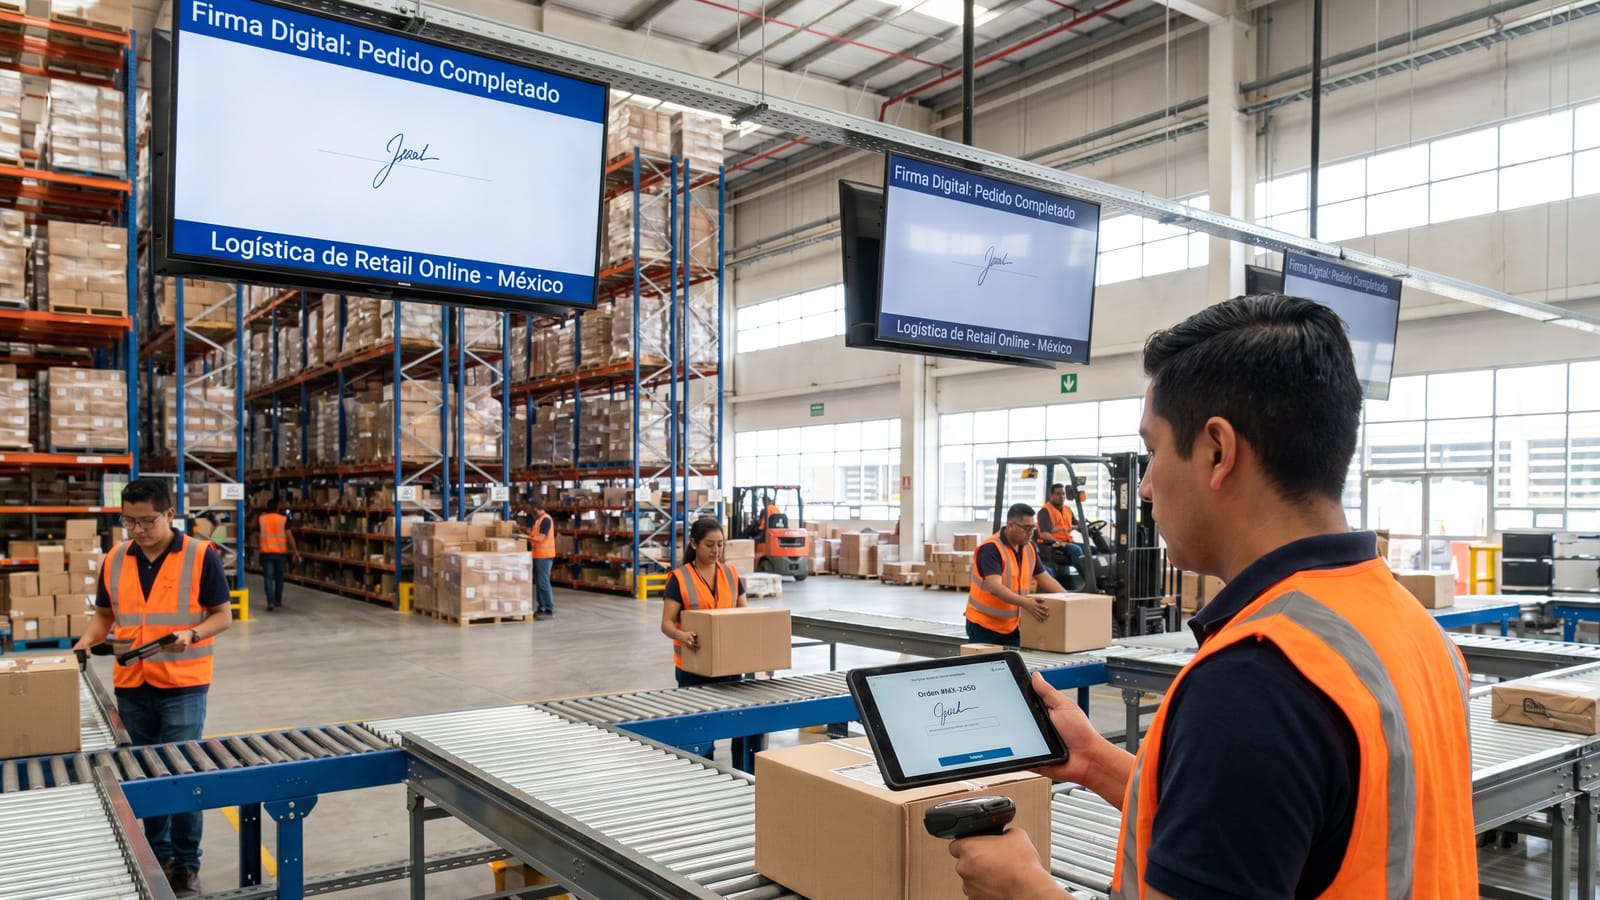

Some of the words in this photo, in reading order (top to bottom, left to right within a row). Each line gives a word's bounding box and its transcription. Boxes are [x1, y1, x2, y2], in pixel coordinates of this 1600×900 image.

[192, 1, 263, 37] Firma
[271, 19, 352, 57] Digital:
[358, 40, 434, 75] Pedido
[439, 60, 560, 104] Completado
[894, 164, 929, 186] Firma
[932, 175, 973, 196] Digital:
[974, 184, 1013, 206] Pedido
[1014, 194, 1076, 220] Completado
[211, 231, 316, 263] Logística
[322, 246, 349, 268] de
[355, 250, 413, 276] Retail
[419, 259, 481, 285] Online
[498, 270, 564, 295] México
[1289, 258, 1307, 273] Firma
[1308, 263, 1331, 279] Digital:
[1331, 269, 1353, 285] Pedido
[1353, 275, 1388, 293] Completado
[897, 319, 948, 340] Logística
[950, 327, 964, 341] de
[966, 328, 996, 345] Retail
[998, 334, 1030, 349] Online
[1037, 338, 1073, 355] México
[917, 690, 940, 698] Orden
